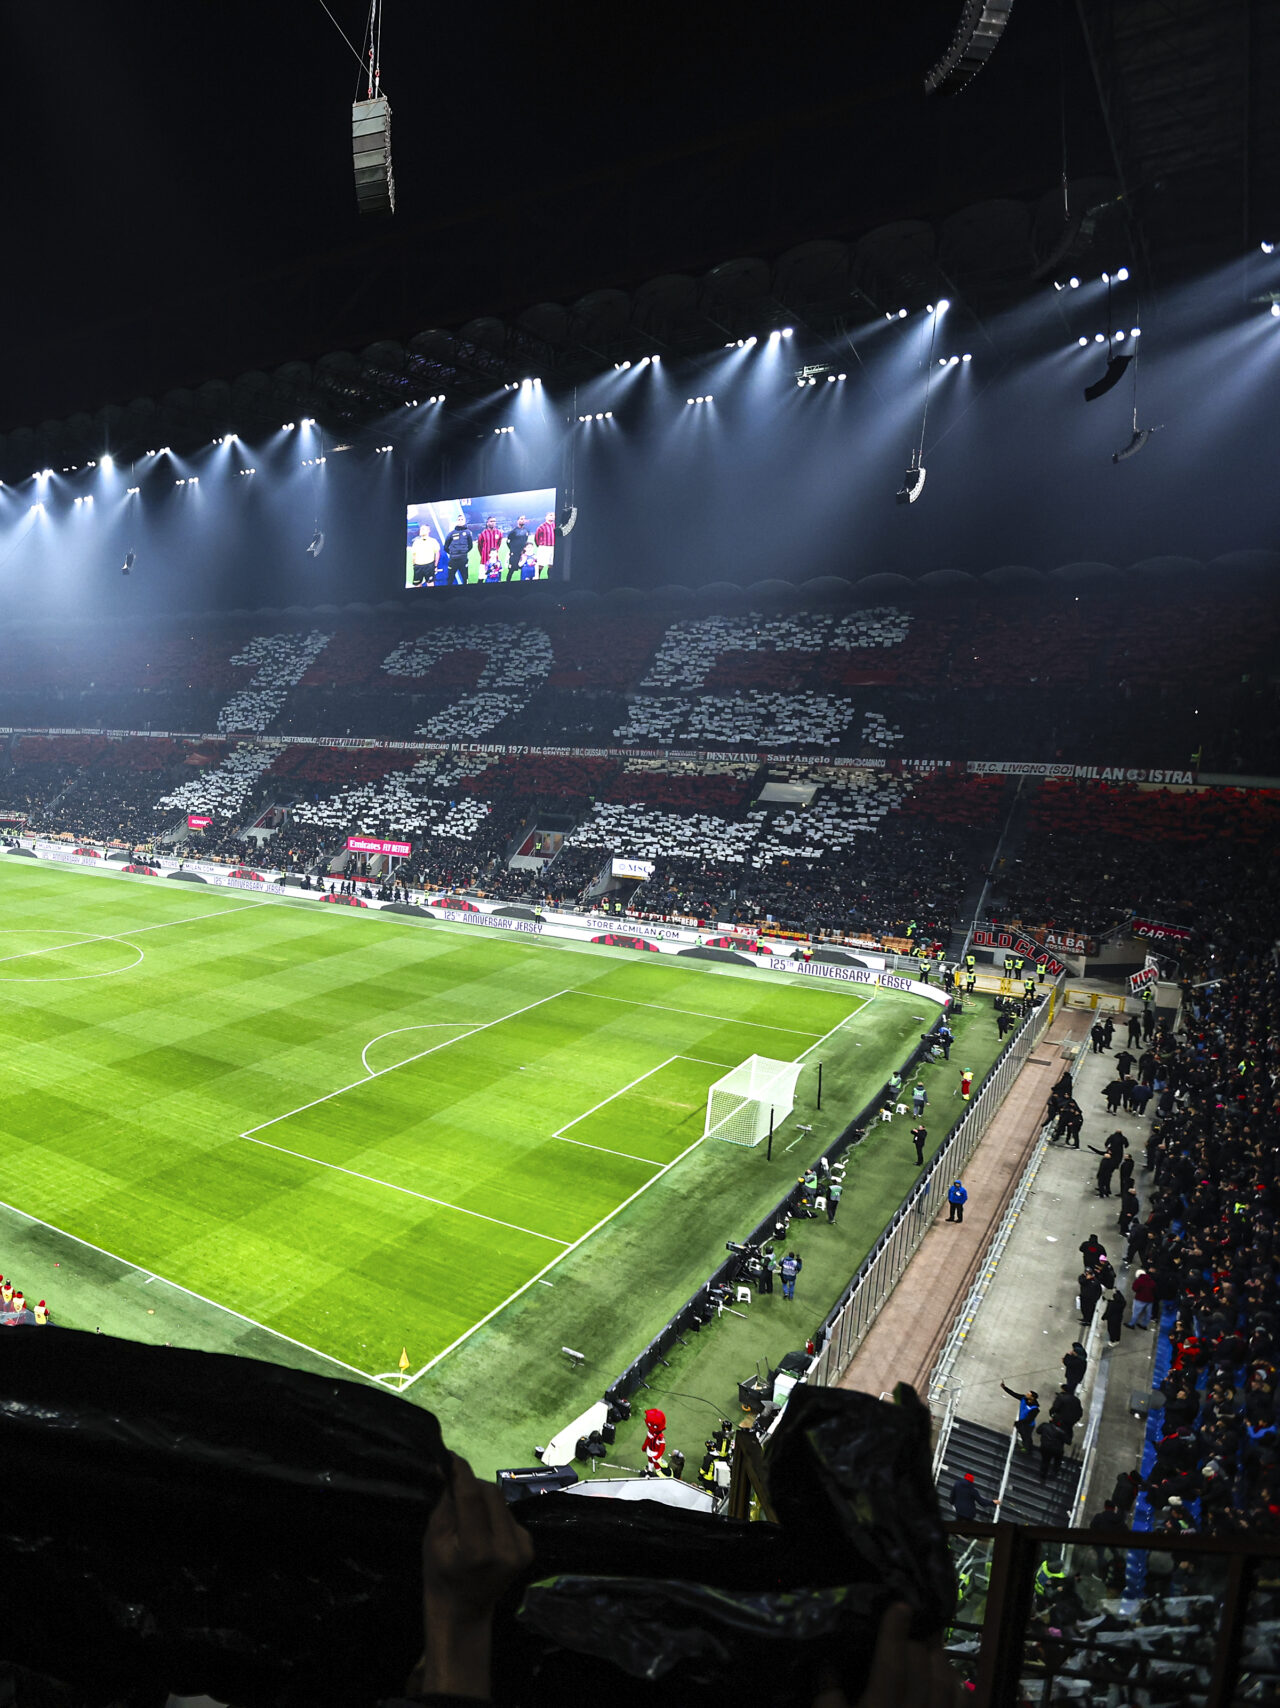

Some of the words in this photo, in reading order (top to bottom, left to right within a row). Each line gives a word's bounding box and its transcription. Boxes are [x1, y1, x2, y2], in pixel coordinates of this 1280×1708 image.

[405, 742, 424, 750] BASSANO
[508, 745, 528, 754] 1973
[767, 754, 830, 765] Sant'Angelo
[1002, 763, 1047, 774] LIVIGNO
[1048, 764, 1073, 776] (SO)
[1073, 765, 1125, 780] MILAN
[1149, 769, 1194, 784] ISTRA
[349, 840, 381, 851] Emirates
[382, 843, 391, 852] FLY
[391, 844, 410, 854] BETTER
[628, 864, 650, 874] MSC
[463, 913, 513, 929] ANNIVERSARY
[514, 921, 543, 933] JERSEY
[1046, 935, 1085, 949] ALBA
[973, 931, 1013, 948] OLD
[1013, 938, 1064, 976] CLAN
[797, 962, 871, 983] ANNIVERSARY
[874, 973, 912, 991] JERSEY
